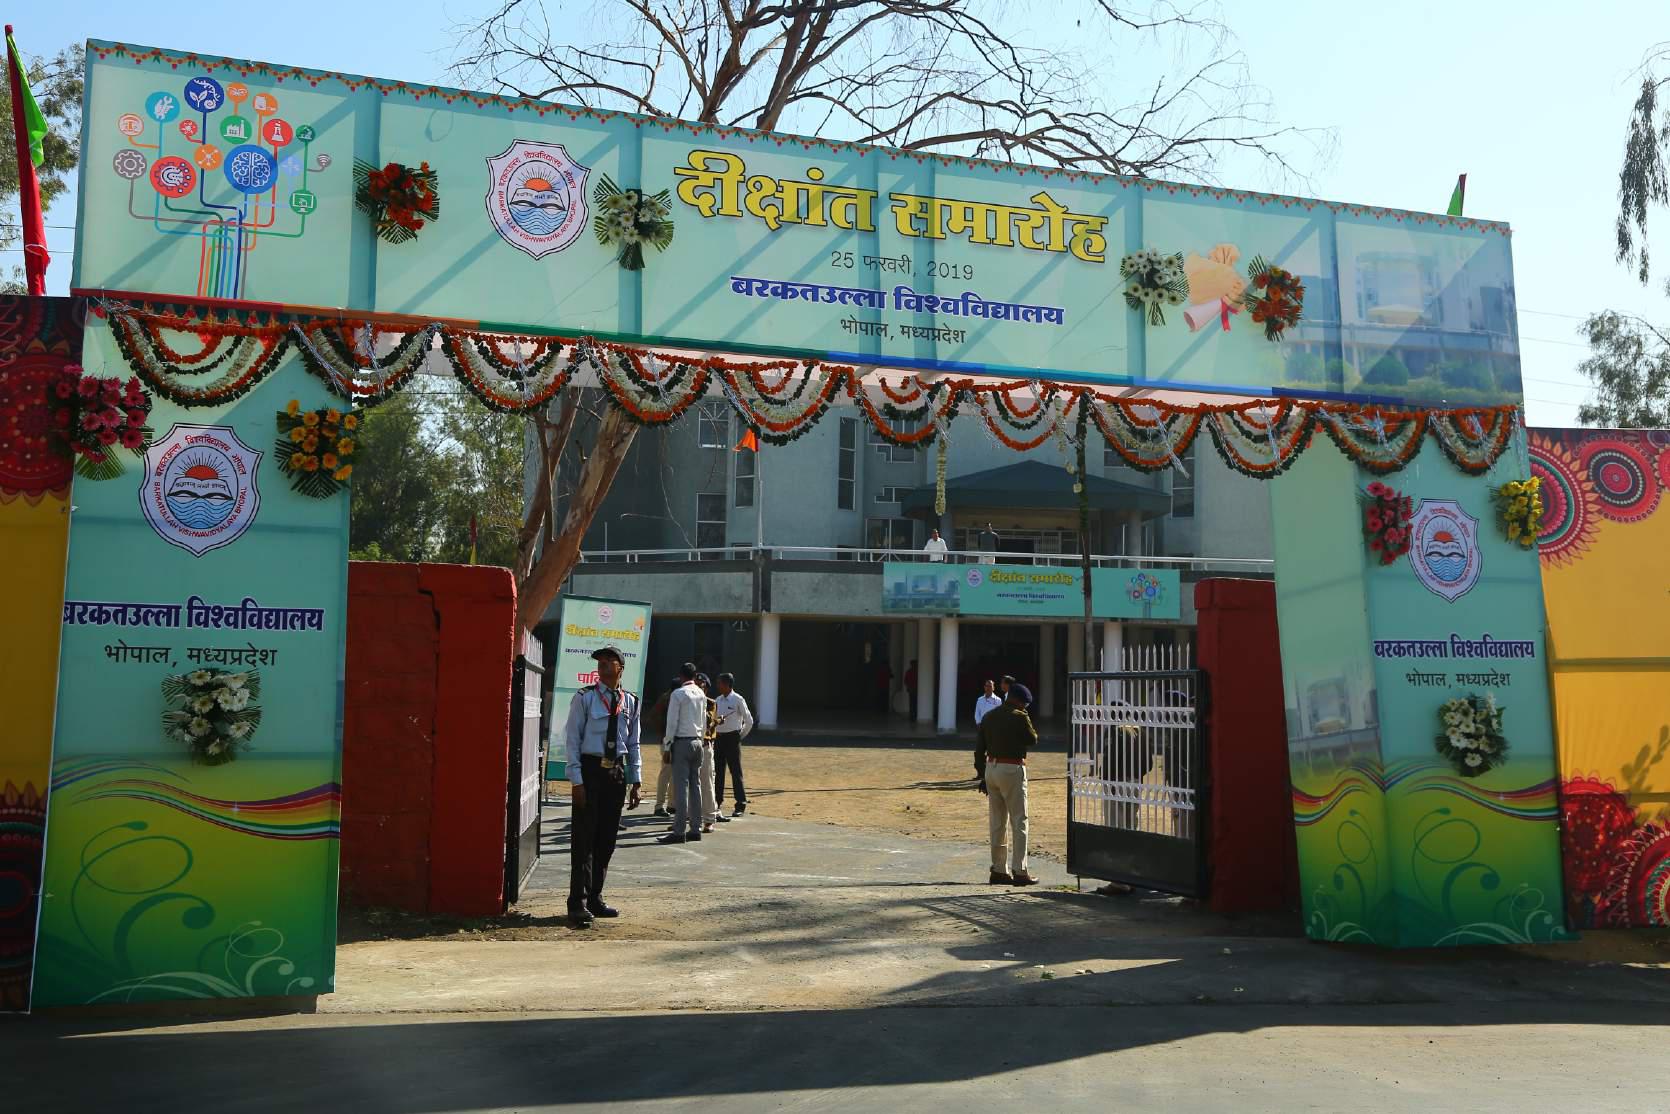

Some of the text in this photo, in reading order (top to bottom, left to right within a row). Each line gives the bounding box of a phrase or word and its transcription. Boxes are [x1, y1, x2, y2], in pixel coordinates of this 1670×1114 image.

[674, 149, 1109, 263] दीक्षांत समारोह
[831, 250, 974, 282] 25 फरवरी, 2019
[730, 275, 1065, 325] बरकतउल्ला विश्वविद्यालय
[840, 315, 966, 344] भोपाल, मध्यप्रदेश
[154, 481, 179, 529] BARKATULLAH
[235, 486, 248, 514] BHOPAL
[62, 596, 325, 632] बरकतउल्ला विश्वविद्यालय
[104, 639, 277, 667] भोपाल, मध्यप्रदेश
[1373, 633, 1536, 660] बरकतउल्ला विश्वविद्यालय
[1406, 667, 1512, 689] भोपाल, मध्यप्रदेश
